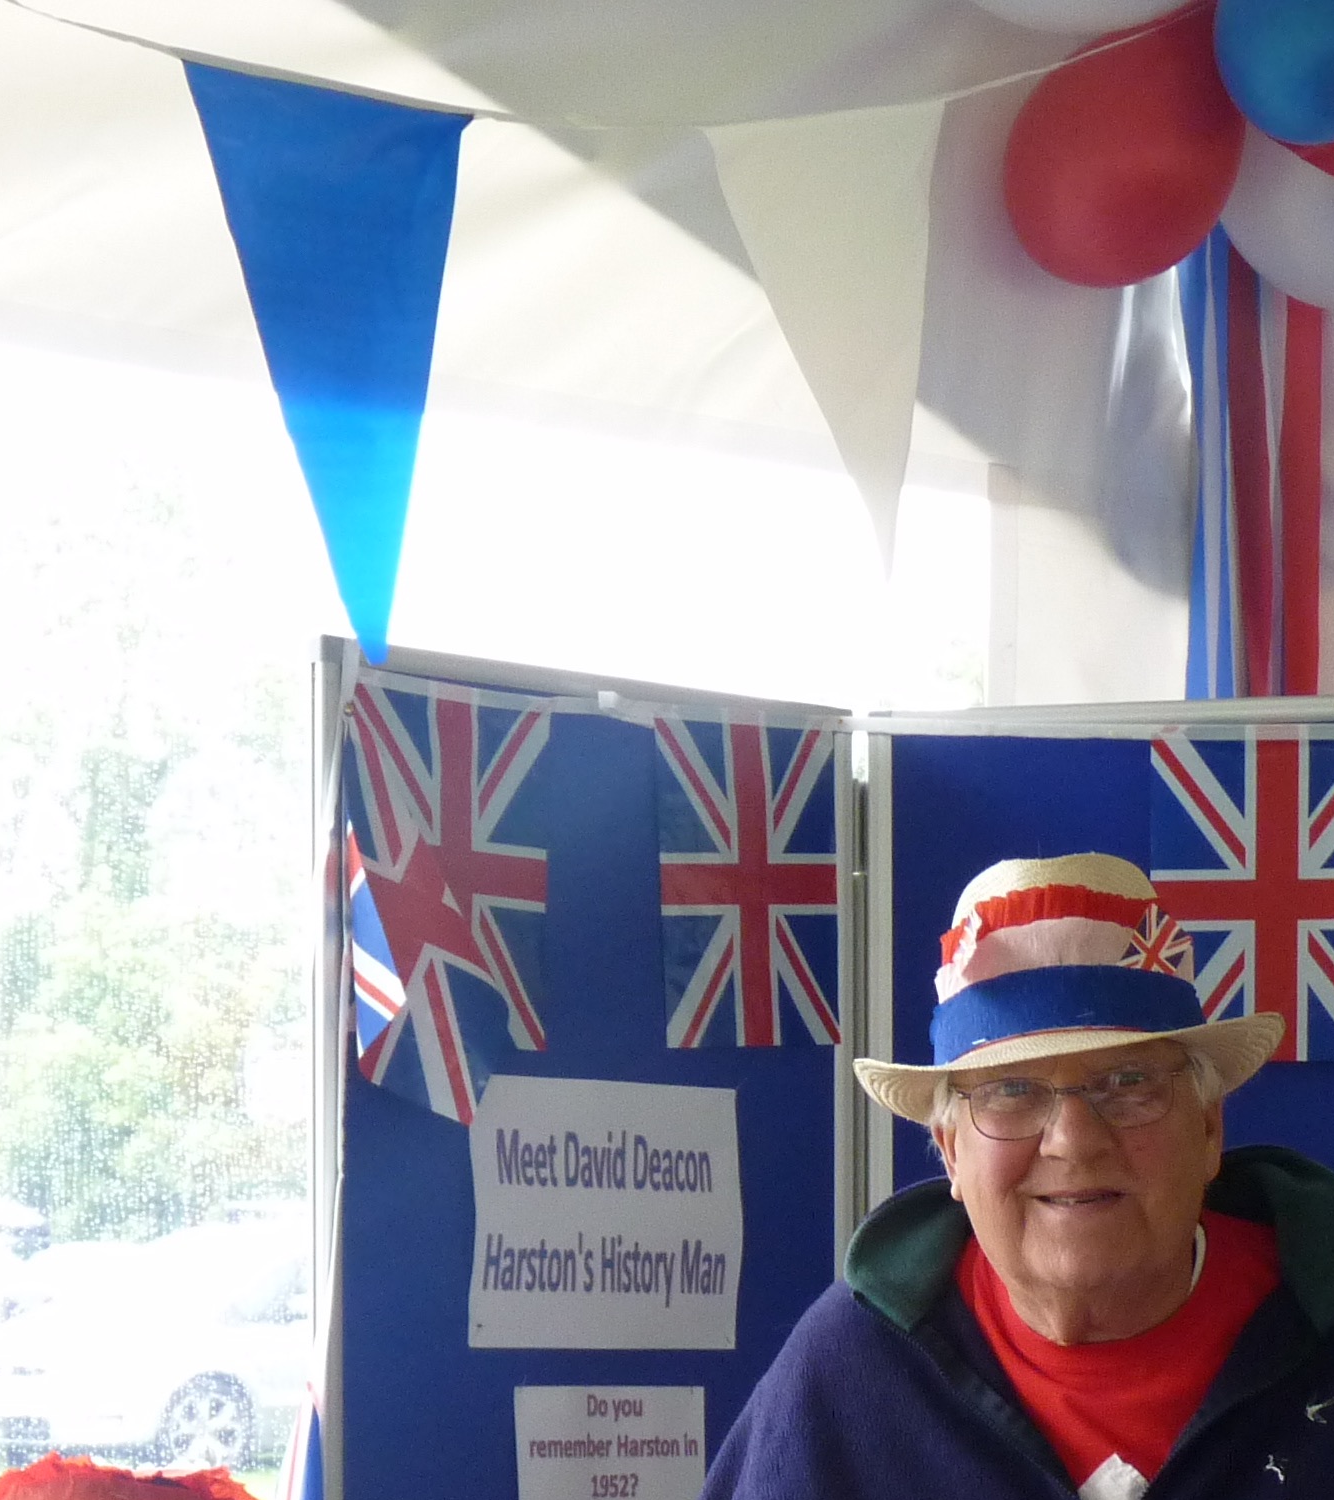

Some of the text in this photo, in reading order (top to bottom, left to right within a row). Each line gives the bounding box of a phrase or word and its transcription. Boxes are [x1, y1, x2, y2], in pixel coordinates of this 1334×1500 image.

[496, 1129, 713, 1192] Meet David Deacon
[482, 1232, 726, 1308] Harston's History Man
[587, 1394, 643, 1422] Do you
[529, 1432, 612, 1458] remember
[617, 1434, 680, 1458] Harston
[591, 1473, 639, 1498] 1952?
